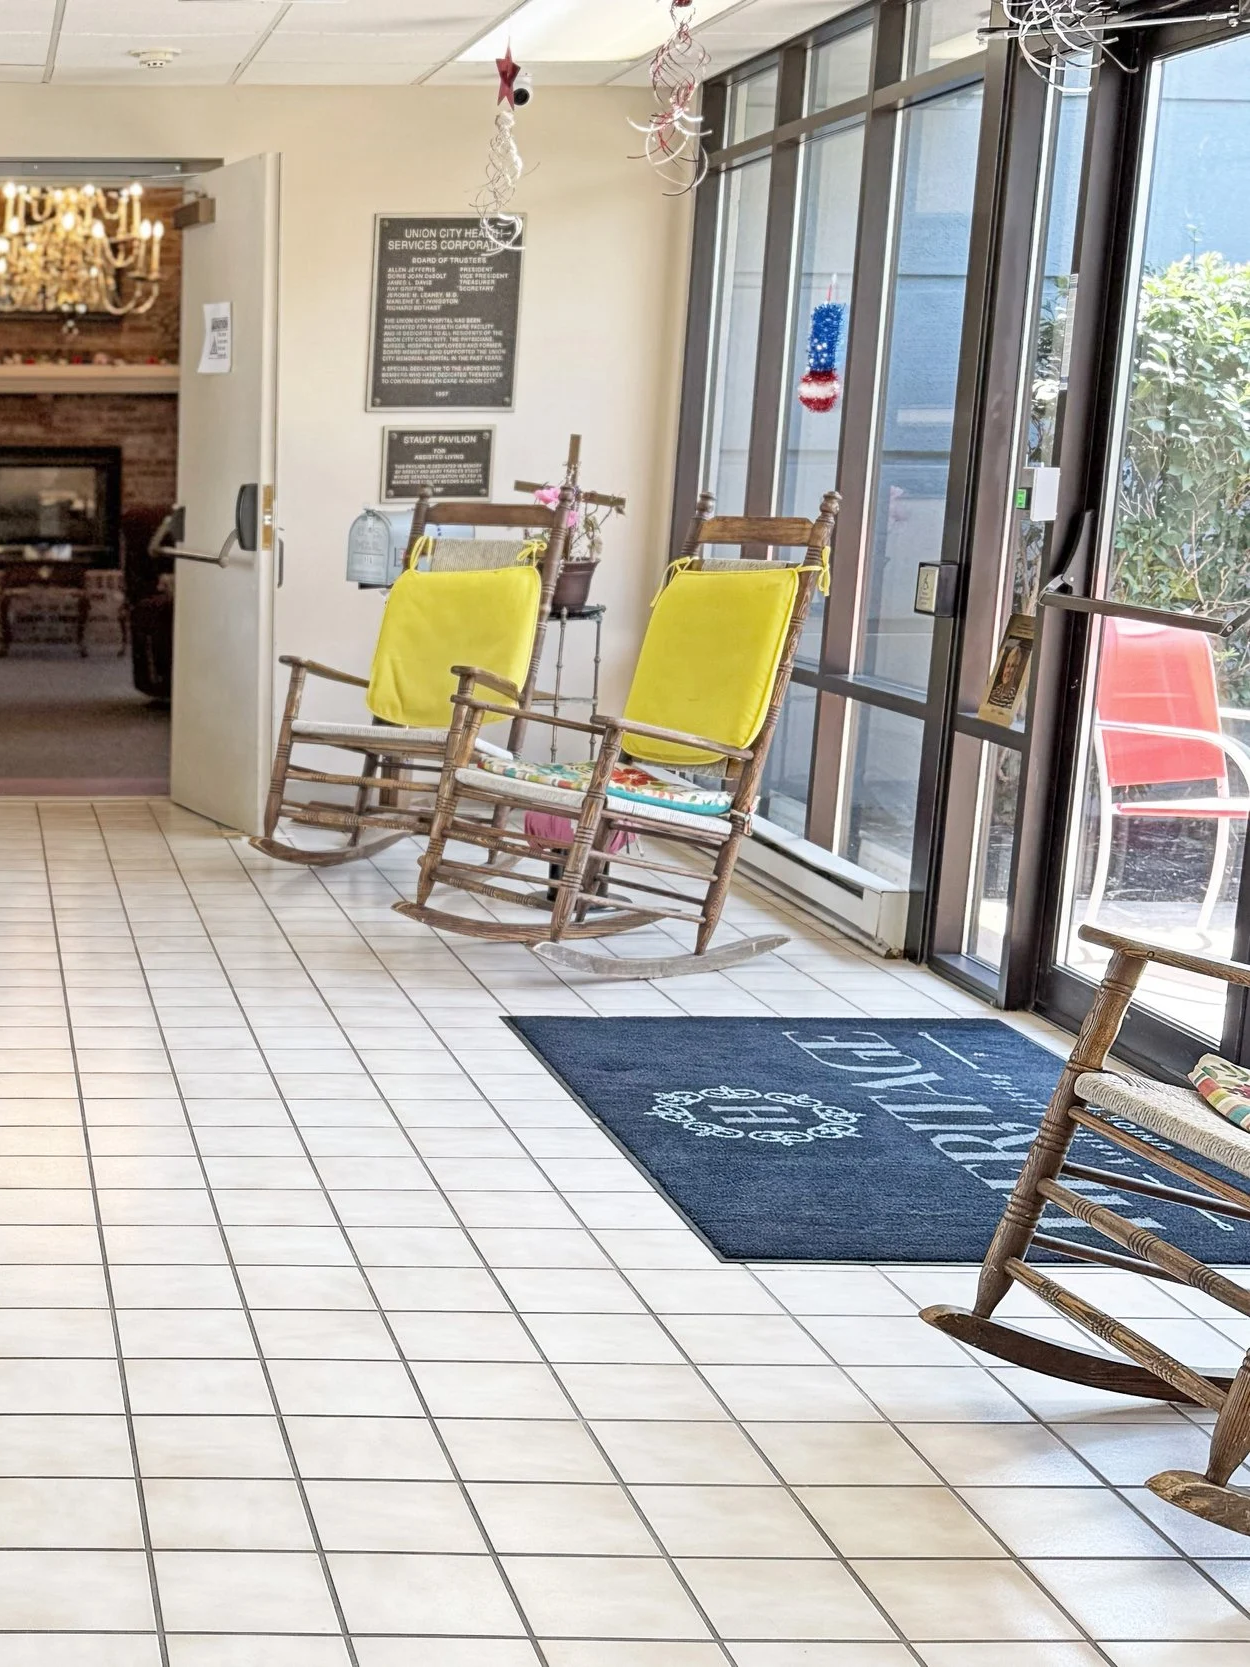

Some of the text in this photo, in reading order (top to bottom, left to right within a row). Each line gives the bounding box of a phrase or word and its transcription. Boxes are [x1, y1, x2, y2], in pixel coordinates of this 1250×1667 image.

[405, 228, 437, 238] UNION
[439, 228, 462, 238] CITY
[388, 240, 513, 250] SERVICES CORPORATION
[438, 435, 477, 443] PAVILION
